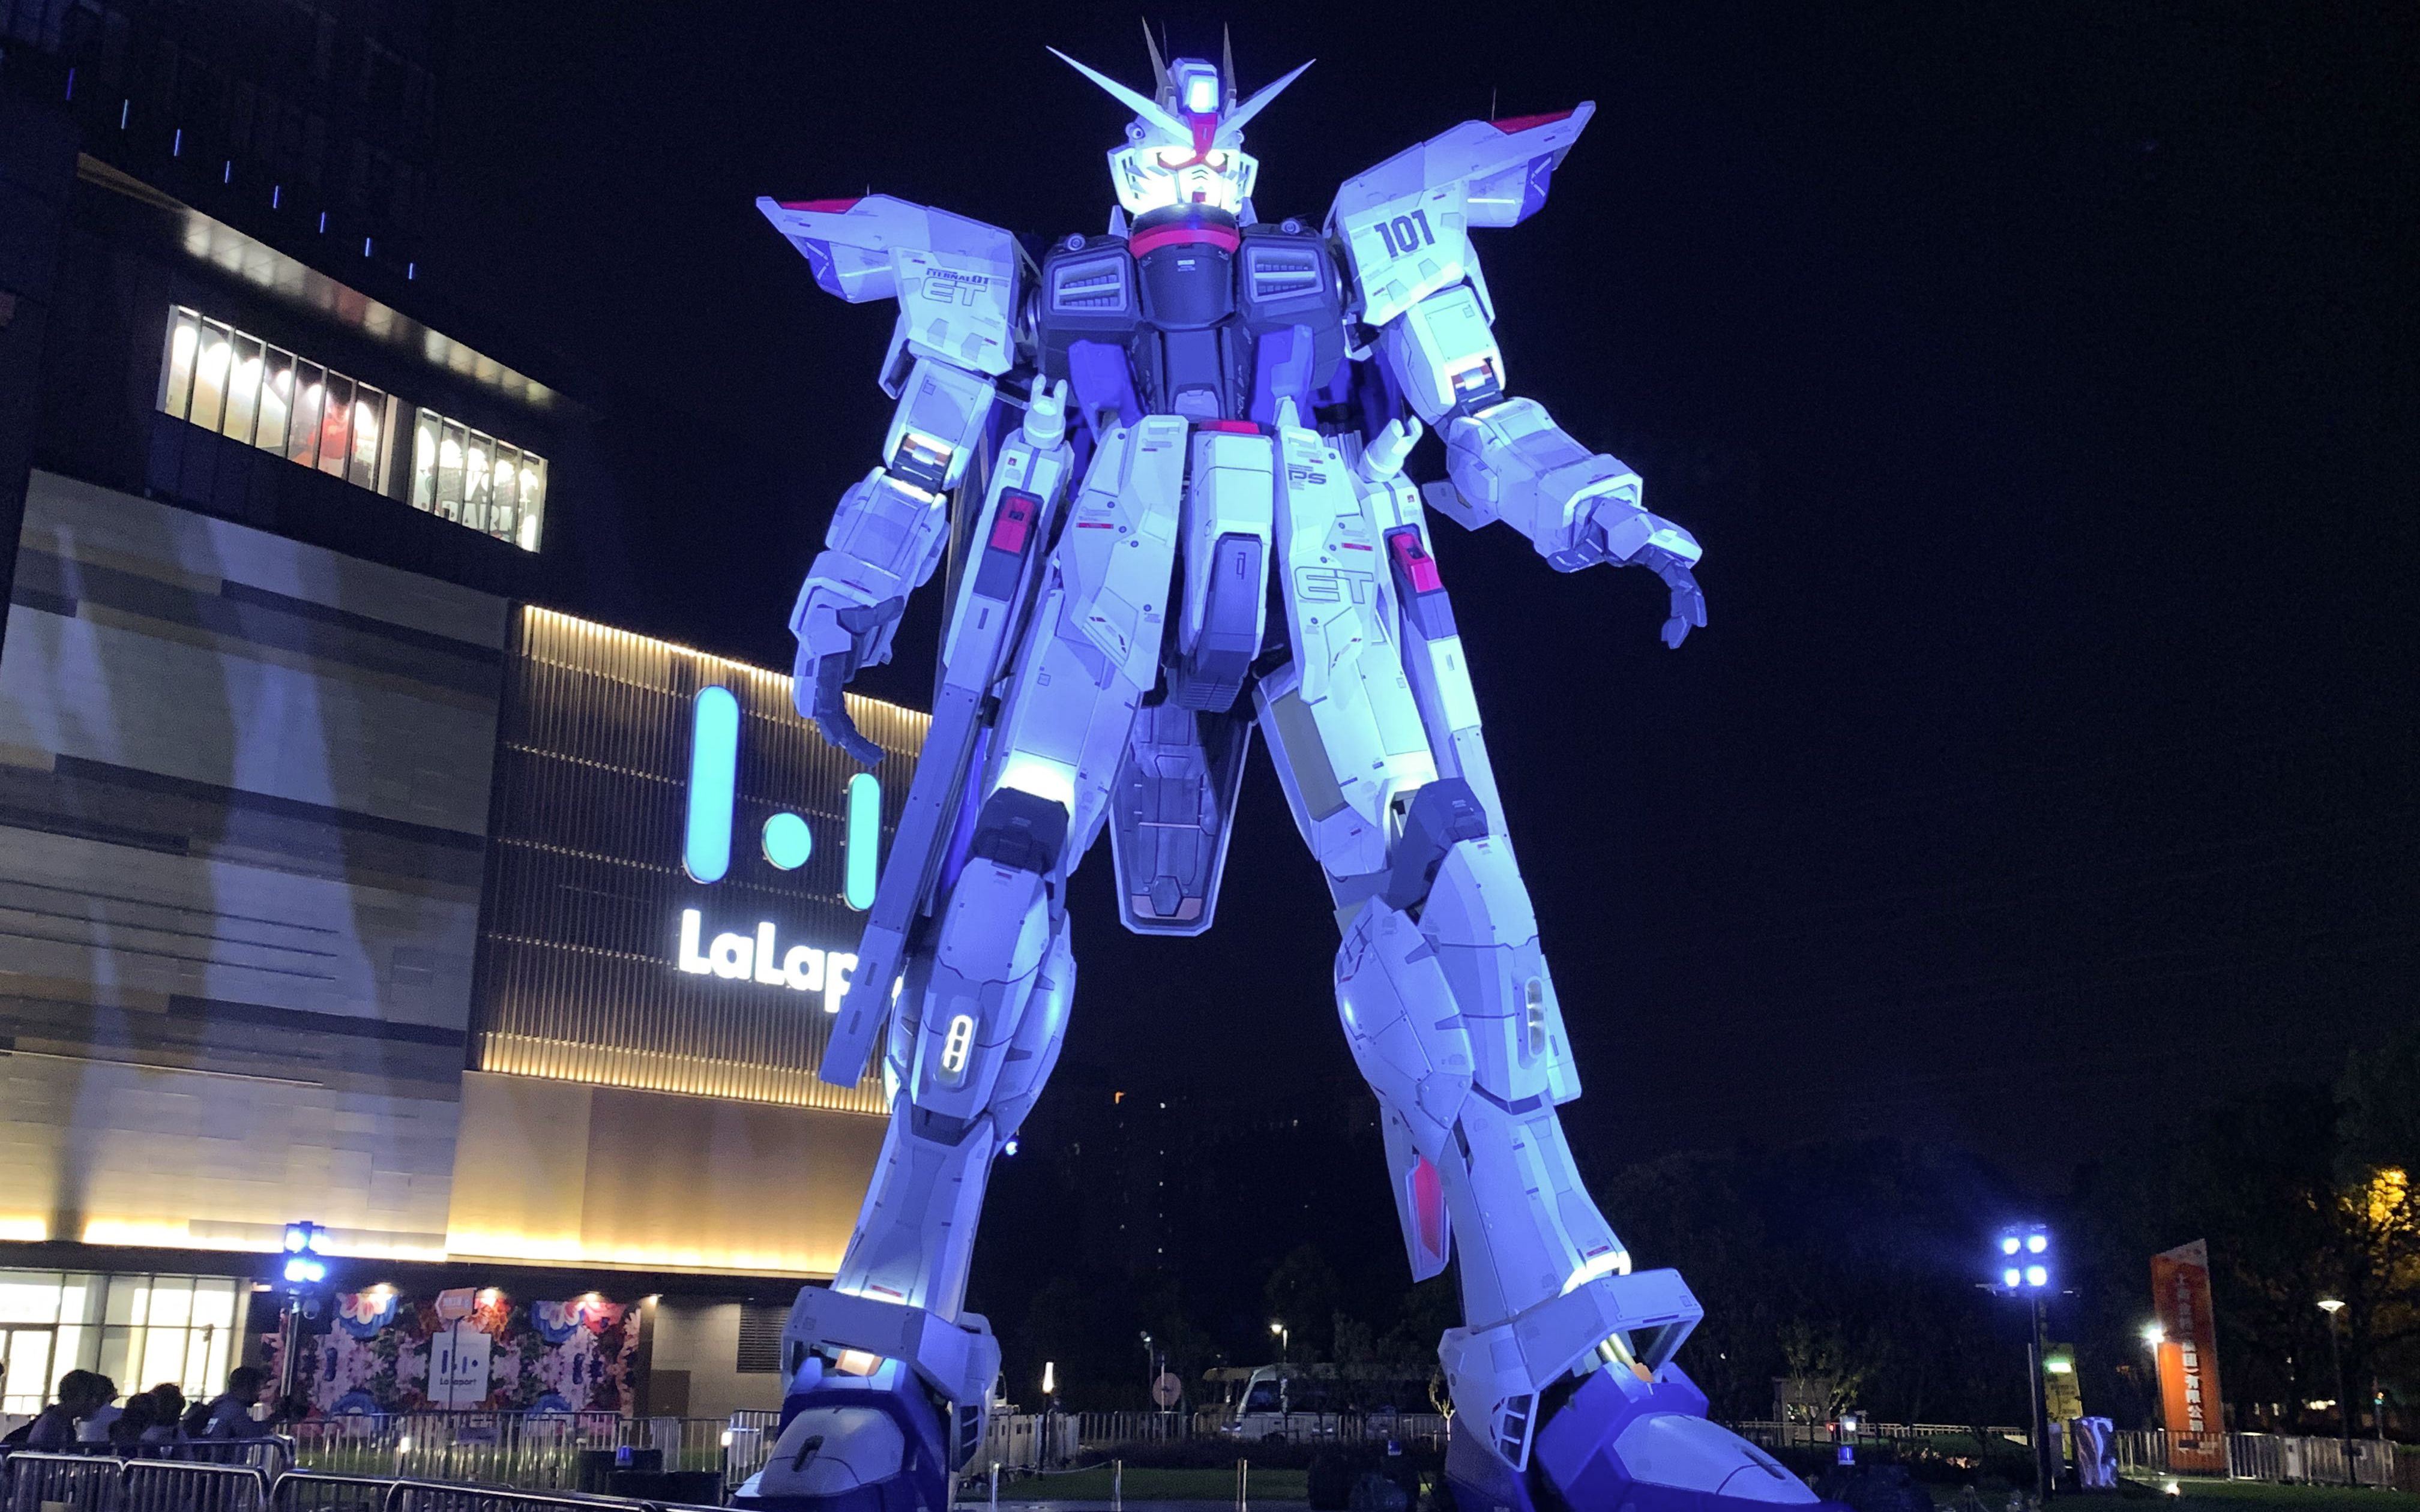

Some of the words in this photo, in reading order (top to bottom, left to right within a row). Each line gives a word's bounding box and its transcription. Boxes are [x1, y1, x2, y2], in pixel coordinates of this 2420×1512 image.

[1373, 209, 1435, 258] 101
[921, 276, 988, 307] ET
[1288, 470, 1326, 485] PS
[1295, 566, 1374, 604] ET
[679, 908, 859, 1013] LaLap
